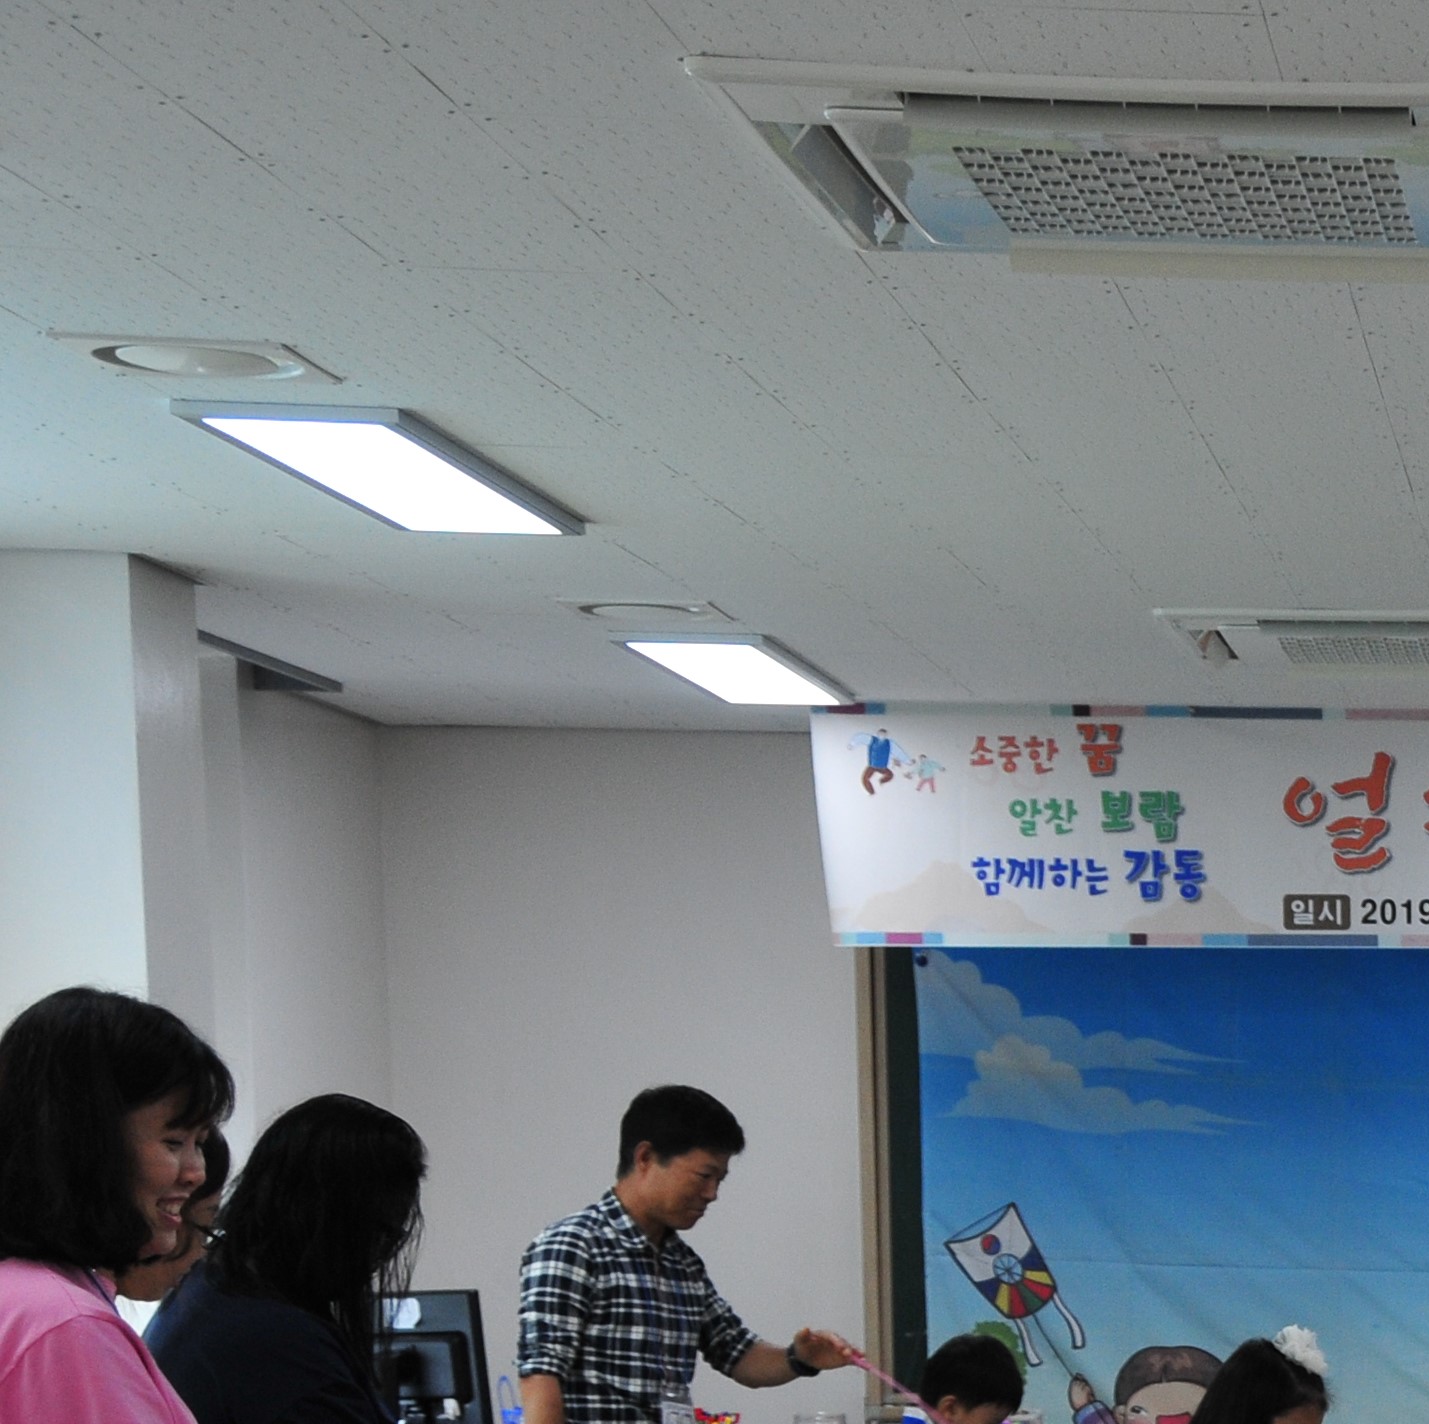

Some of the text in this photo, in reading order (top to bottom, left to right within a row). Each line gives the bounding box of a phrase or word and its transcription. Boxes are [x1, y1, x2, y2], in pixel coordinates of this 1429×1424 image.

[970, 723, 1122, 776] 소중한 꿈
[1009, 790, 1185, 843] 알찬 보람
[971, 850, 1207, 901] 함께하는 감동
[1289, 898, 1343, 927] 일시
